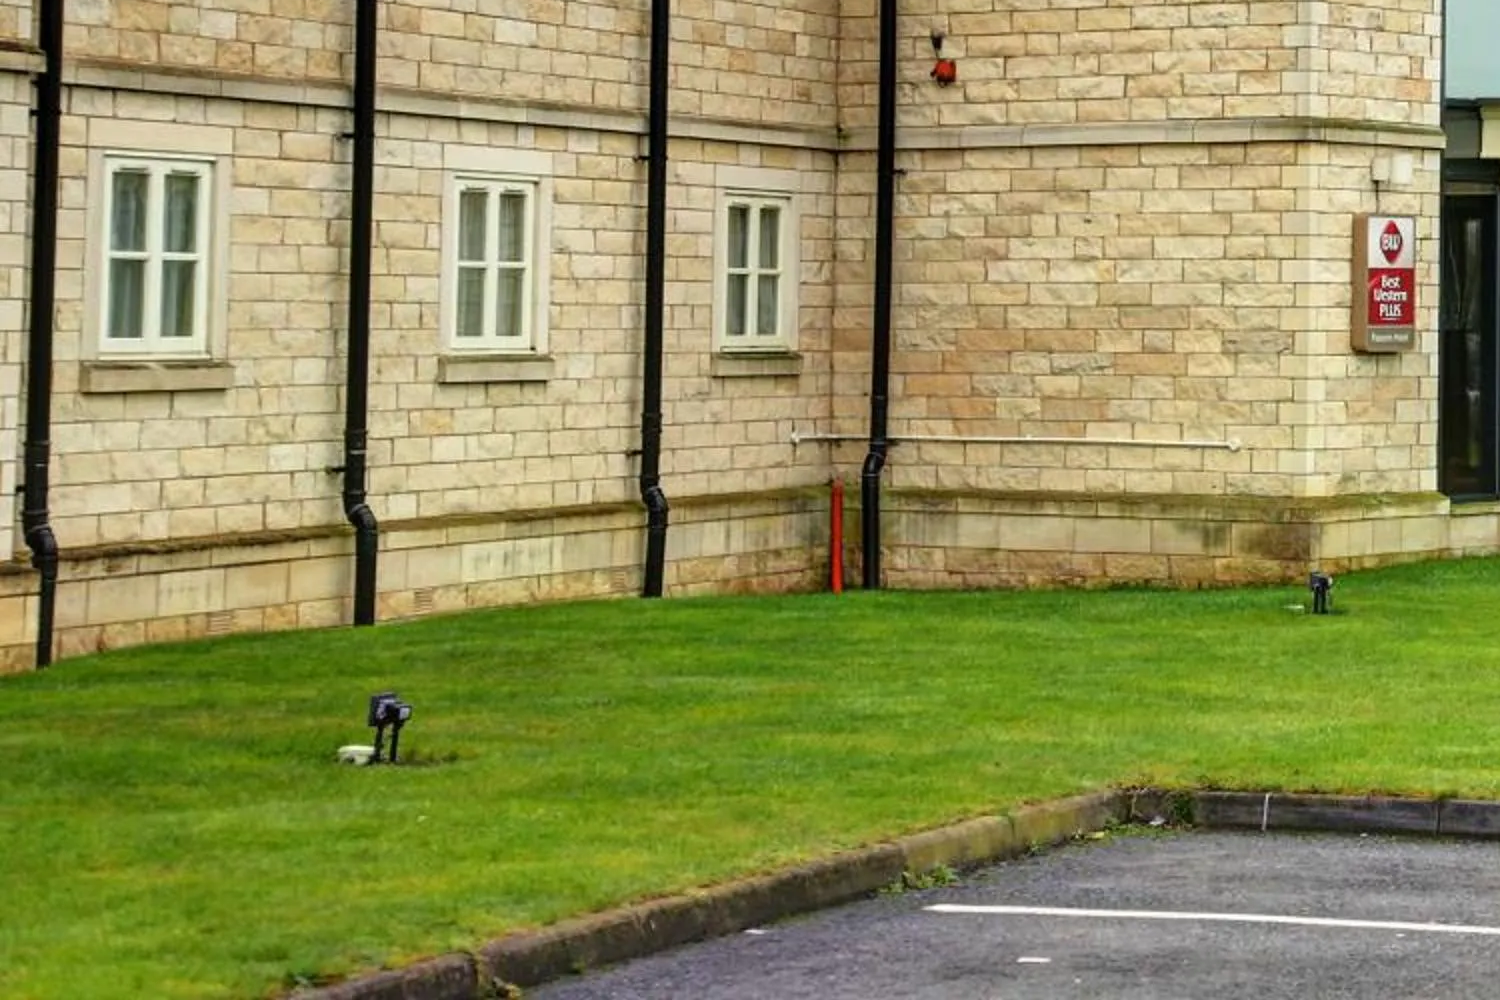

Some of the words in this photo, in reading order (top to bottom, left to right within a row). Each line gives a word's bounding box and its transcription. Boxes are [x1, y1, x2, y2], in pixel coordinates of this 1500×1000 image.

[1381, 275, 1401, 288] Best
[1374, 289, 1407, 301] Western
[1380, 303, 1401, 317] PLUS
